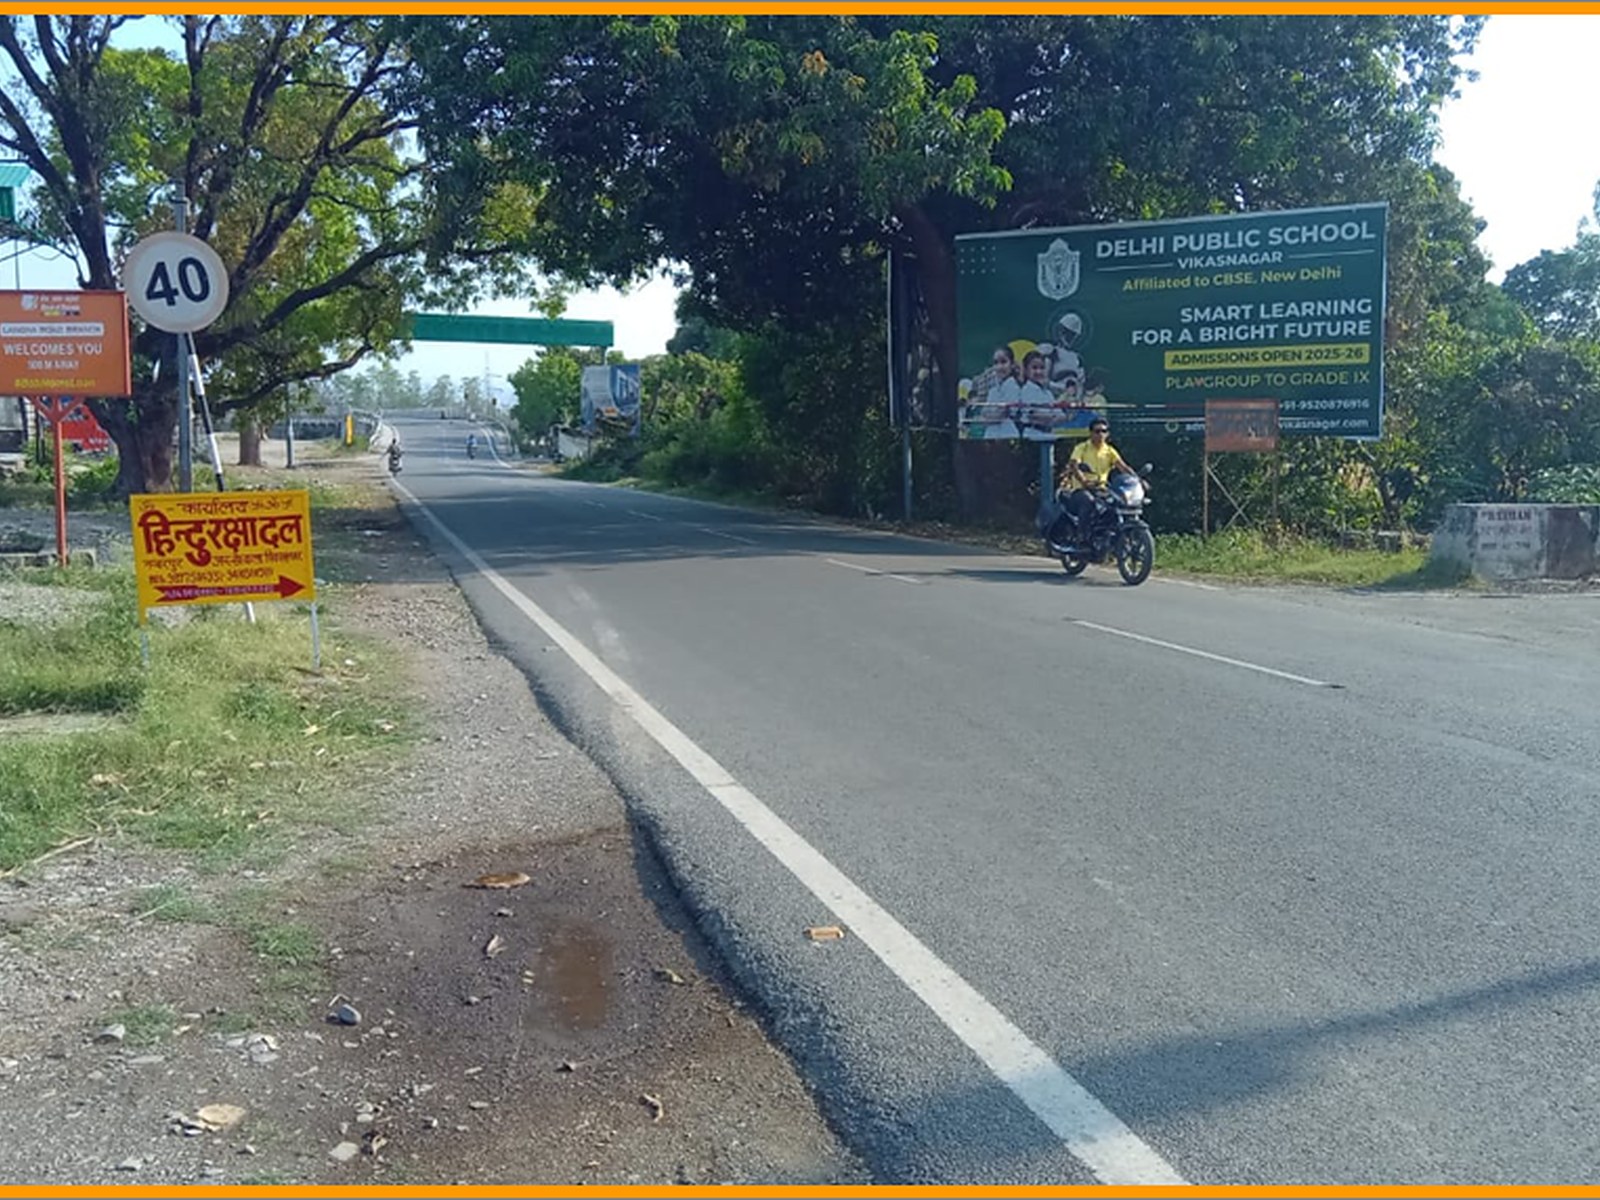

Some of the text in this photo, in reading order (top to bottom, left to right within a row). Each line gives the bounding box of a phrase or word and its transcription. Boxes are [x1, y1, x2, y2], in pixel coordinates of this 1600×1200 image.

[1096, 221, 1376, 258] DELHI PUBLIC SCHOOL
[1178, 251, 1283, 269] VIKASNAGAR
[145, 256, 210, 307] 40
[1122, 274, 1191, 292] Affiliated
[1194, 274, 1210, 288] to
[1261, 269, 1296, 284] New
[1300, 265, 1342, 281] Delhi
[1180, 298, 1373, 324] SMART LEARNING
[1132, 320, 1372, 345] FOR A BRIGHT FUTURE
[3, 342, 103, 356] WELCOMES YOU
[1170, 346, 1364, 366] ADMISSIONS OPEN 2025-26
[1166, 369, 1370, 389] PLAYGROUP TO GRADE IX
